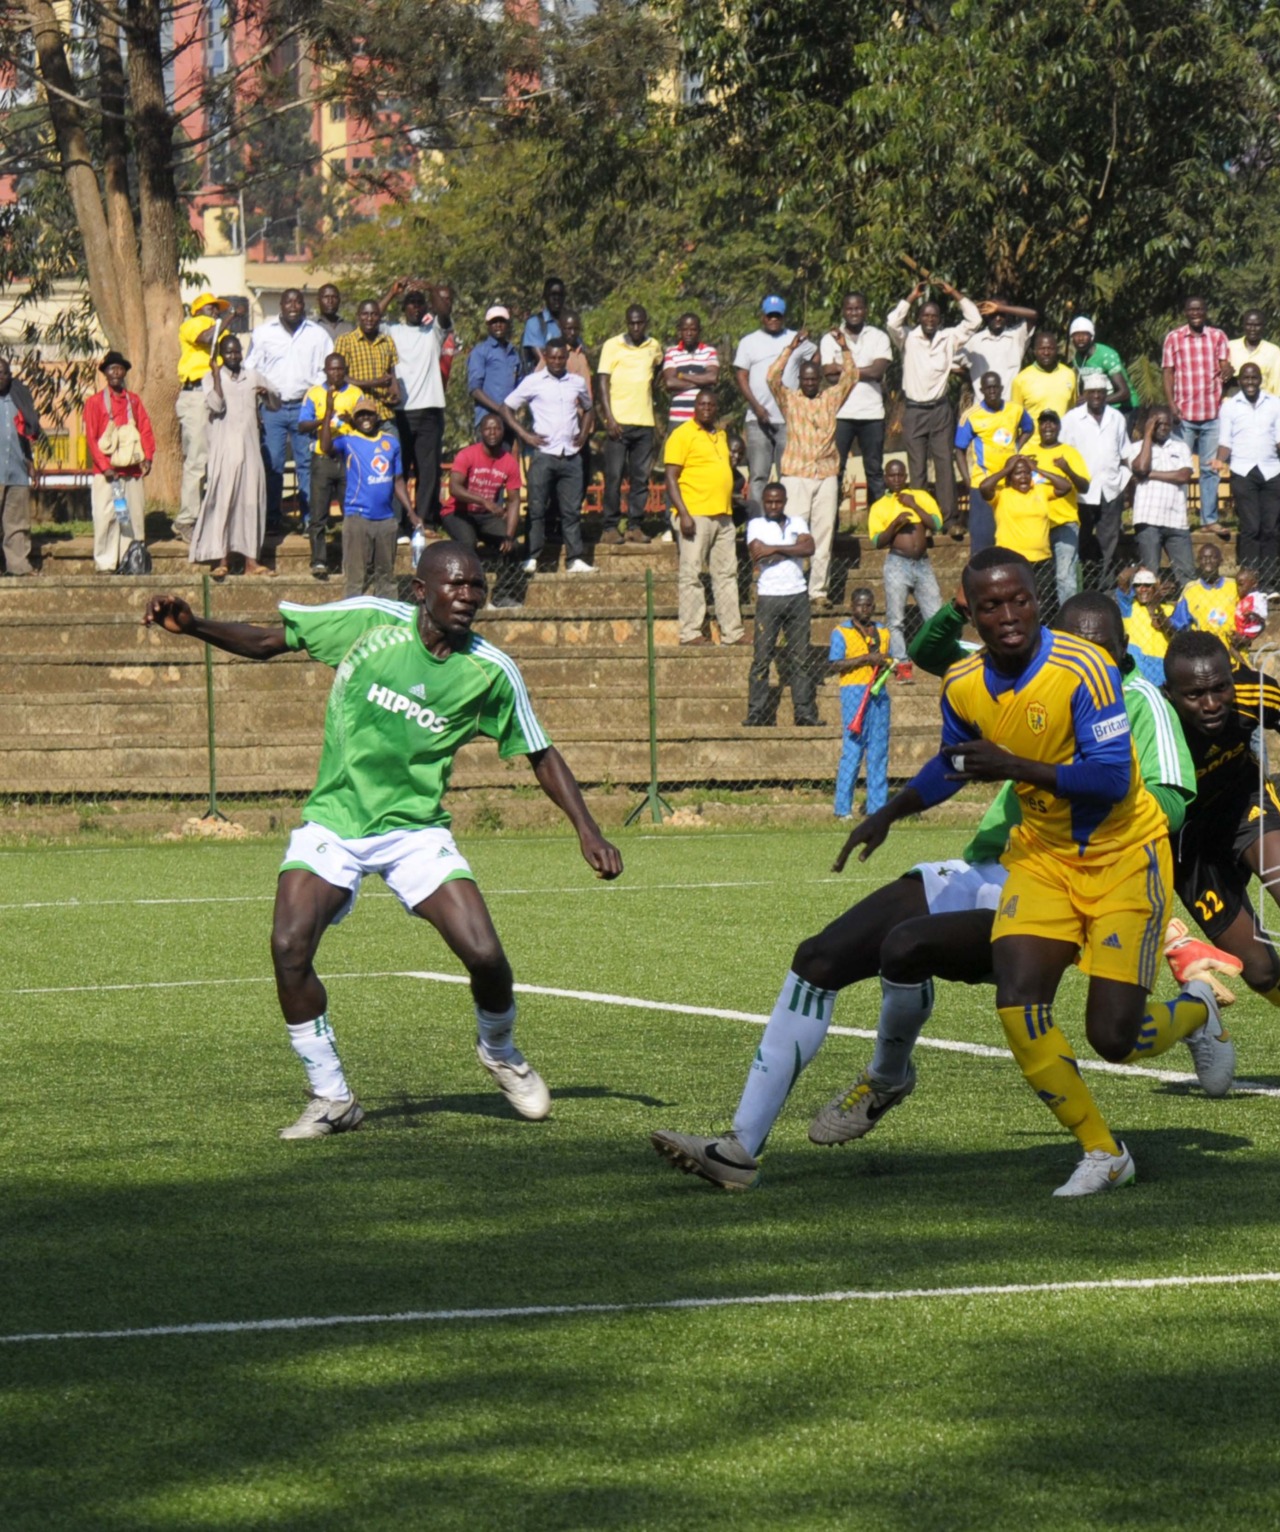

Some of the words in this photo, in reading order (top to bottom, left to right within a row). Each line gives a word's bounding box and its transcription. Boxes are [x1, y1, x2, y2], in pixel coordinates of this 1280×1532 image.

[367, 683, 449, 733] HIPPOS
[316, 842, 329, 854] 6
[1195, 890, 1224, 921] 22
